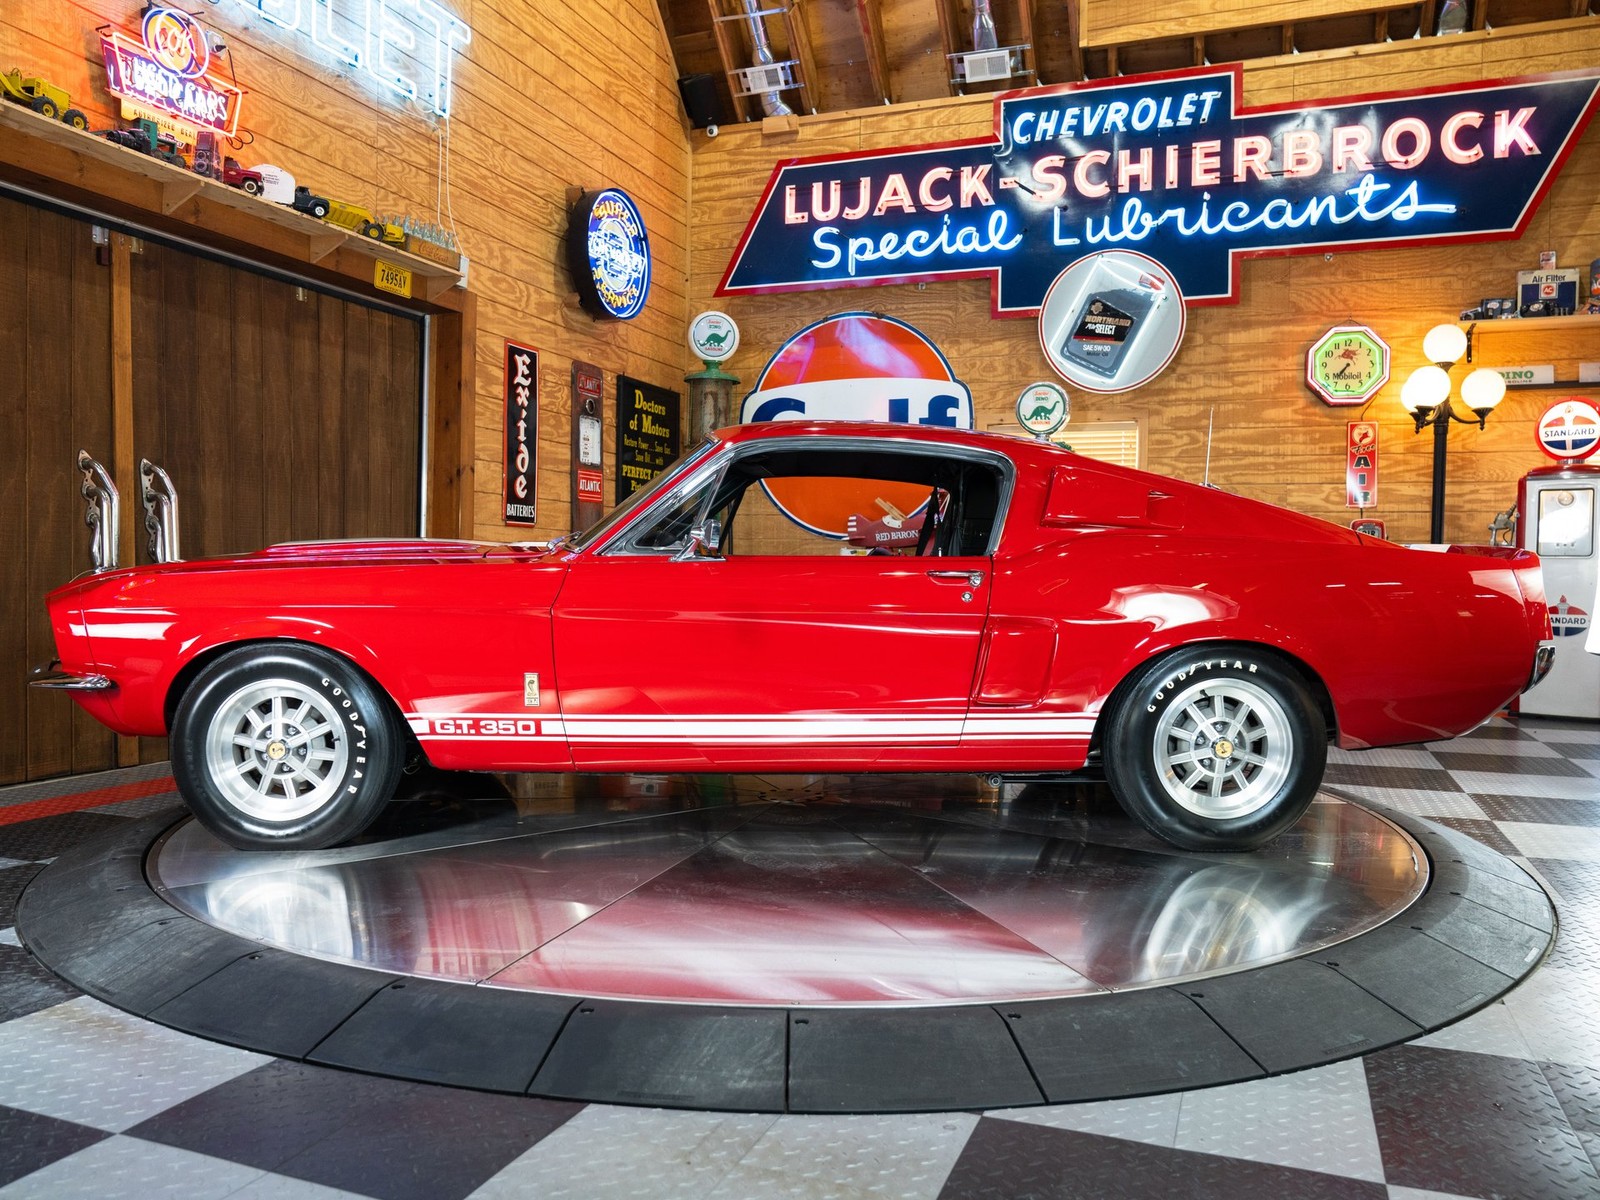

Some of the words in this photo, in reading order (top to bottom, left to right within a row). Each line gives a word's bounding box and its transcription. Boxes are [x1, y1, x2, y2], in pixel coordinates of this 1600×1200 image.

[1012, 90, 1222, 145] CHEVROLET
[811, 208, 1023, 275] Special
[1053, 173, 1456, 246] Lubricants
[1532, 275, 1543, 283] Air
[1546, 274, 1566, 282] Filter
[1084, 315, 1131, 327] NORTHLAND
[1095, 324, 1116, 335] SELECT
[1334, 342, 1340, 350] 11
[1344, 339, 1352, 347] 12
[1324, 350, 1334, 358] 10
[1366, 348, 1372, 356] 2
[1321, 361, 1328, 369] 9
[1369, 360, 1375, 368] 3
[1333, 372, 1362, 380] Mobiloil
[1366, 371, 1372, 379] 4
[634, 389, 666, 416] Doctors
[513, 353, 532, 500] Exide
[629, 413, 638, 431] of
[642, 413, 670, 438] Motors
[1544, 428, 1595, 438] STANDARD
[1350, 444, 1375, 454] Free
[622, 464, 651, 480] PERFECT
[579, 480, 601, 493] ATLANTIC
[506, 503, 535, 518] BATTERIES
[875, 531, 891, 541] RED
[891, 530, 919, 540] BARON
[1550, 617, 1586, 625] ANDARD
[1147, 659, 1258, 713] GOODYEAR
[434, 719, 476, 734] G.T.
[479, 719, 536, 735] 350
[321, 677, 367, 794] GOODYEAR
